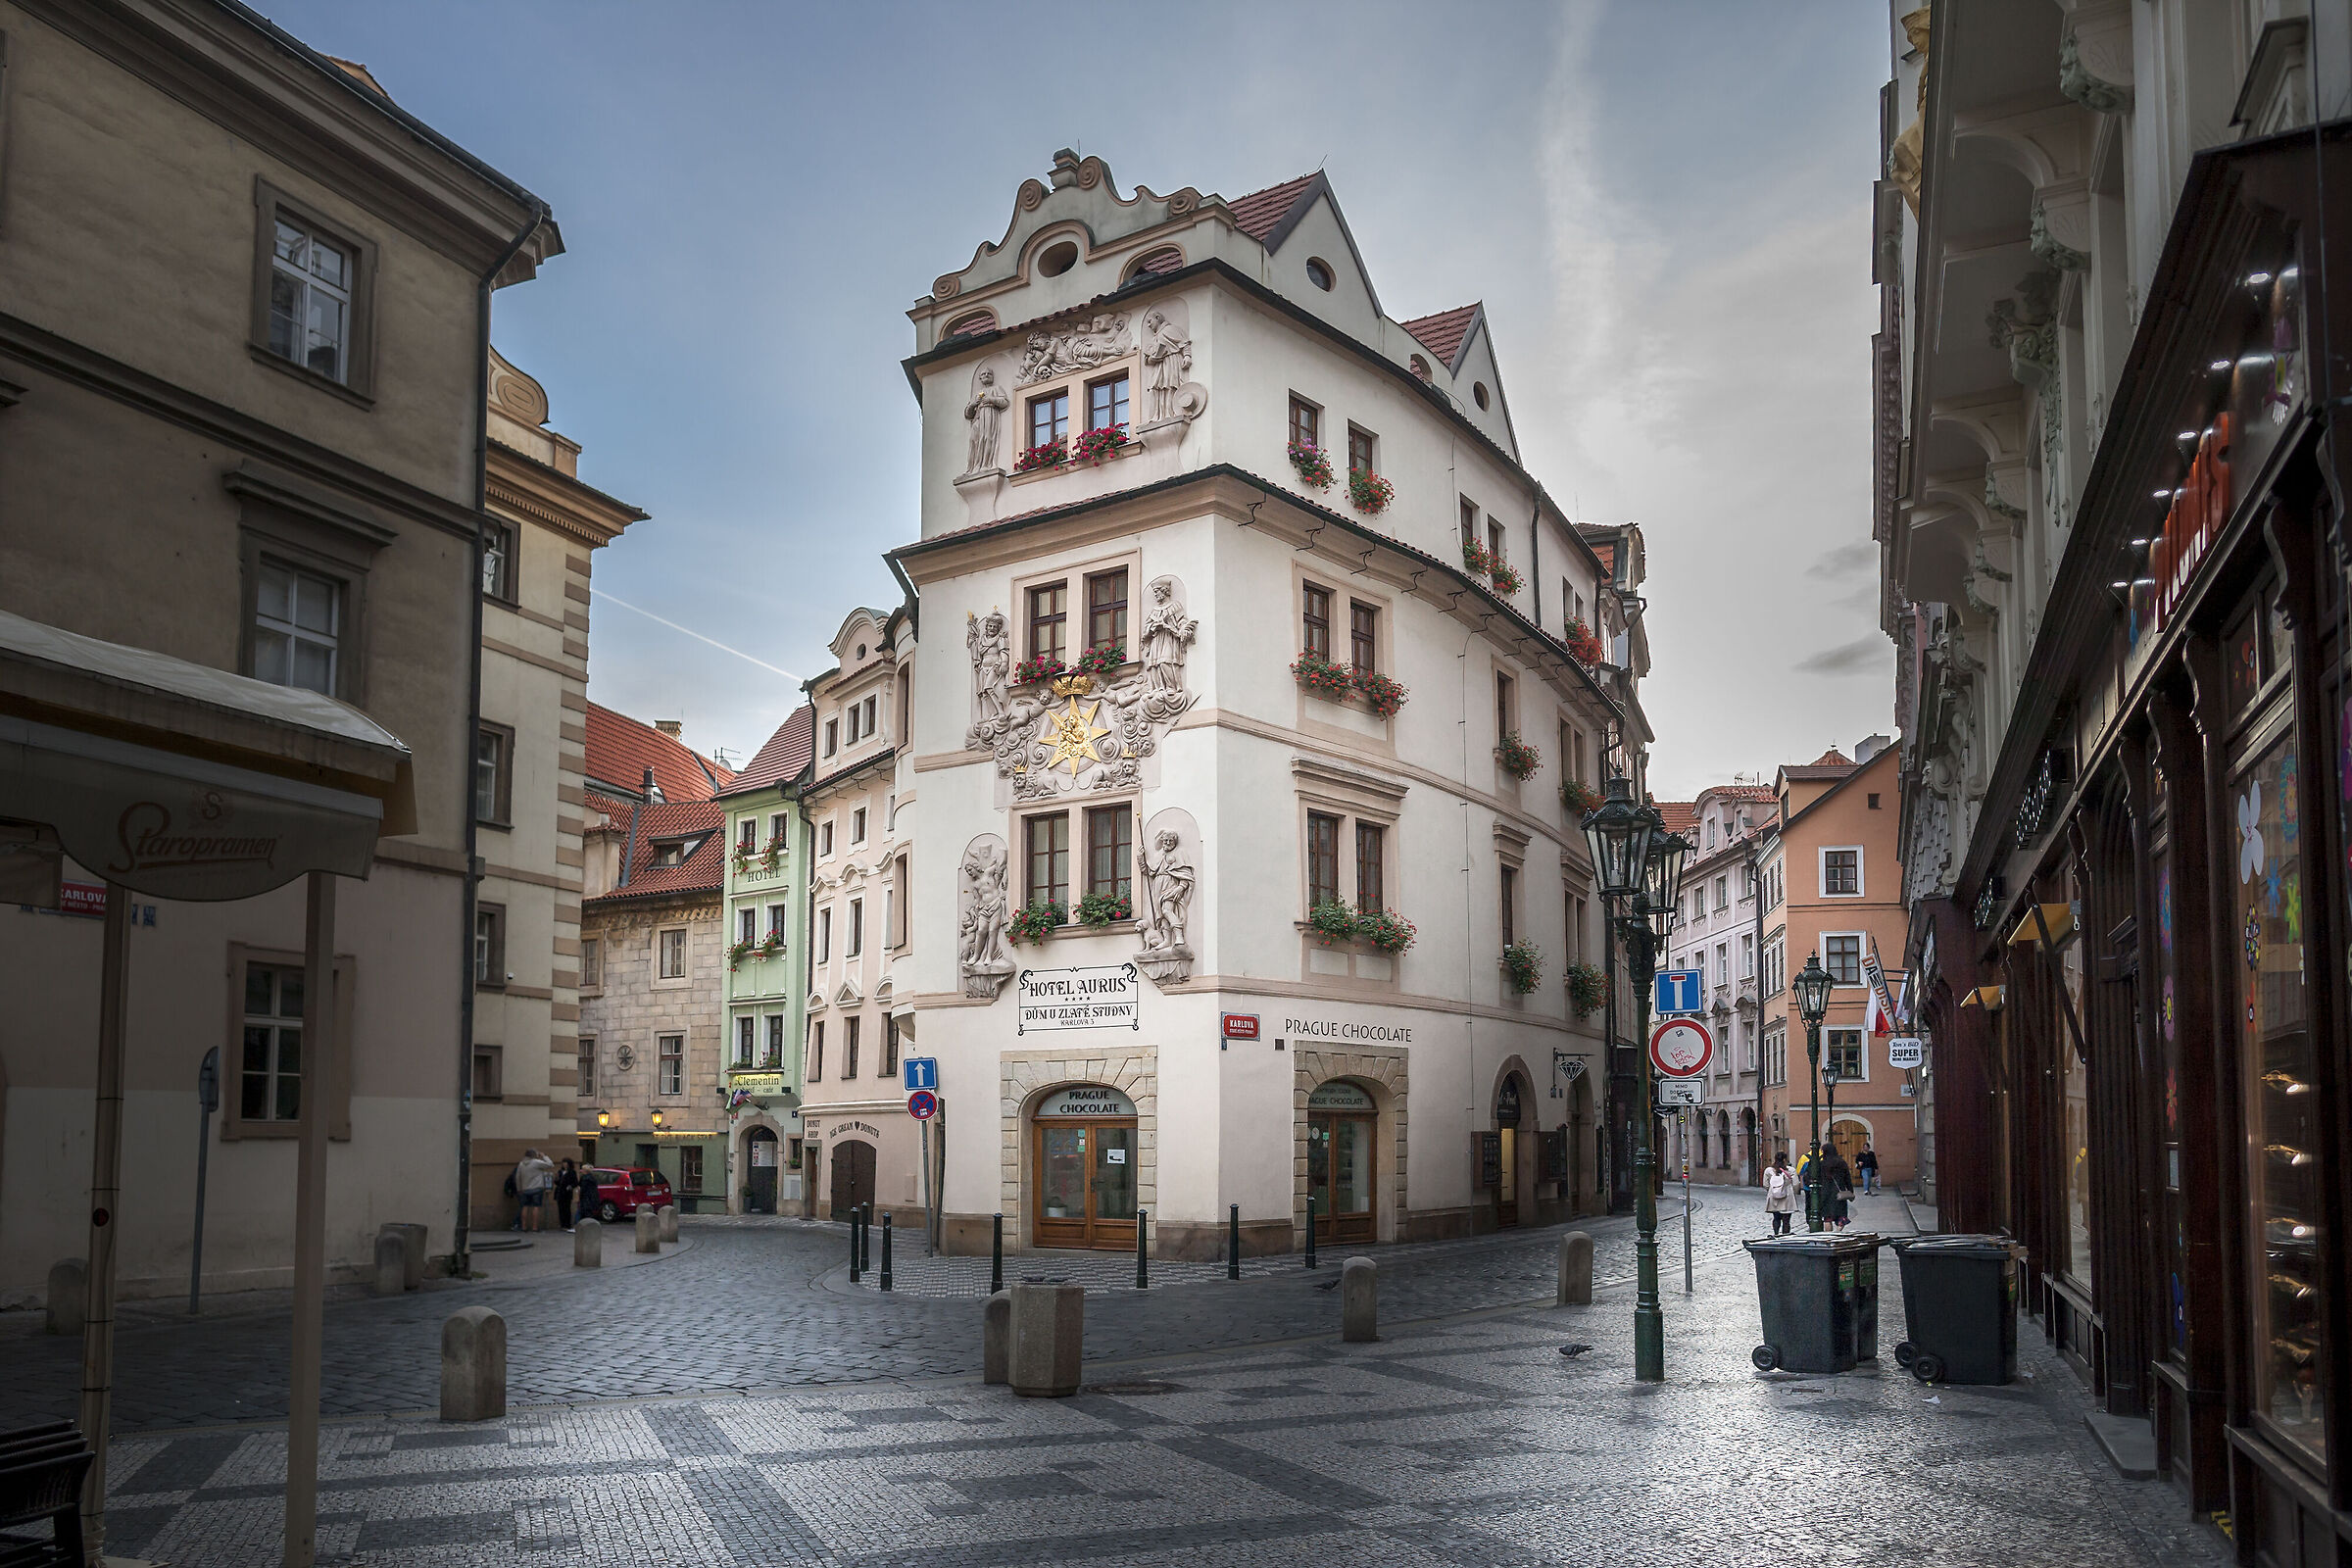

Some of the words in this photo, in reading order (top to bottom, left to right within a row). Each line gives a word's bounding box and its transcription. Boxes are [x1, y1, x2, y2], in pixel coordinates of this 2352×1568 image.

[108, 801, 277, 873] Staropramen
[748, 867, 781, 882] HOTEL
[1029, 980, 1075, 997] HOTEL
[1076, 978, 1127, 994] AURUS
[1025, 1007, 1048, 1020] DŮM
[1050, 1009, 1056, 1019] U
[1058, 1004, 1091, 1018] ZLATÉ
[1093, 1004, 1133, 1017] STUDNY
[1229, 1019, 1254, 1029] KARLOVA
[1285, 1018, 1338, 1037] PRAGUE
[1342, 1023, 1412, 1042] CHOCOLATE
[1892, 1049, 1919, 1057] SUPER
[737, 1076, 779, 1086] Clementin
[1069, 1091, 1109, 1100] PRAGUE
[1330, 1097, 1364, 1105] CHOCOLATE
[1059, 1103, 1119, 1113] CHOCOLATE
